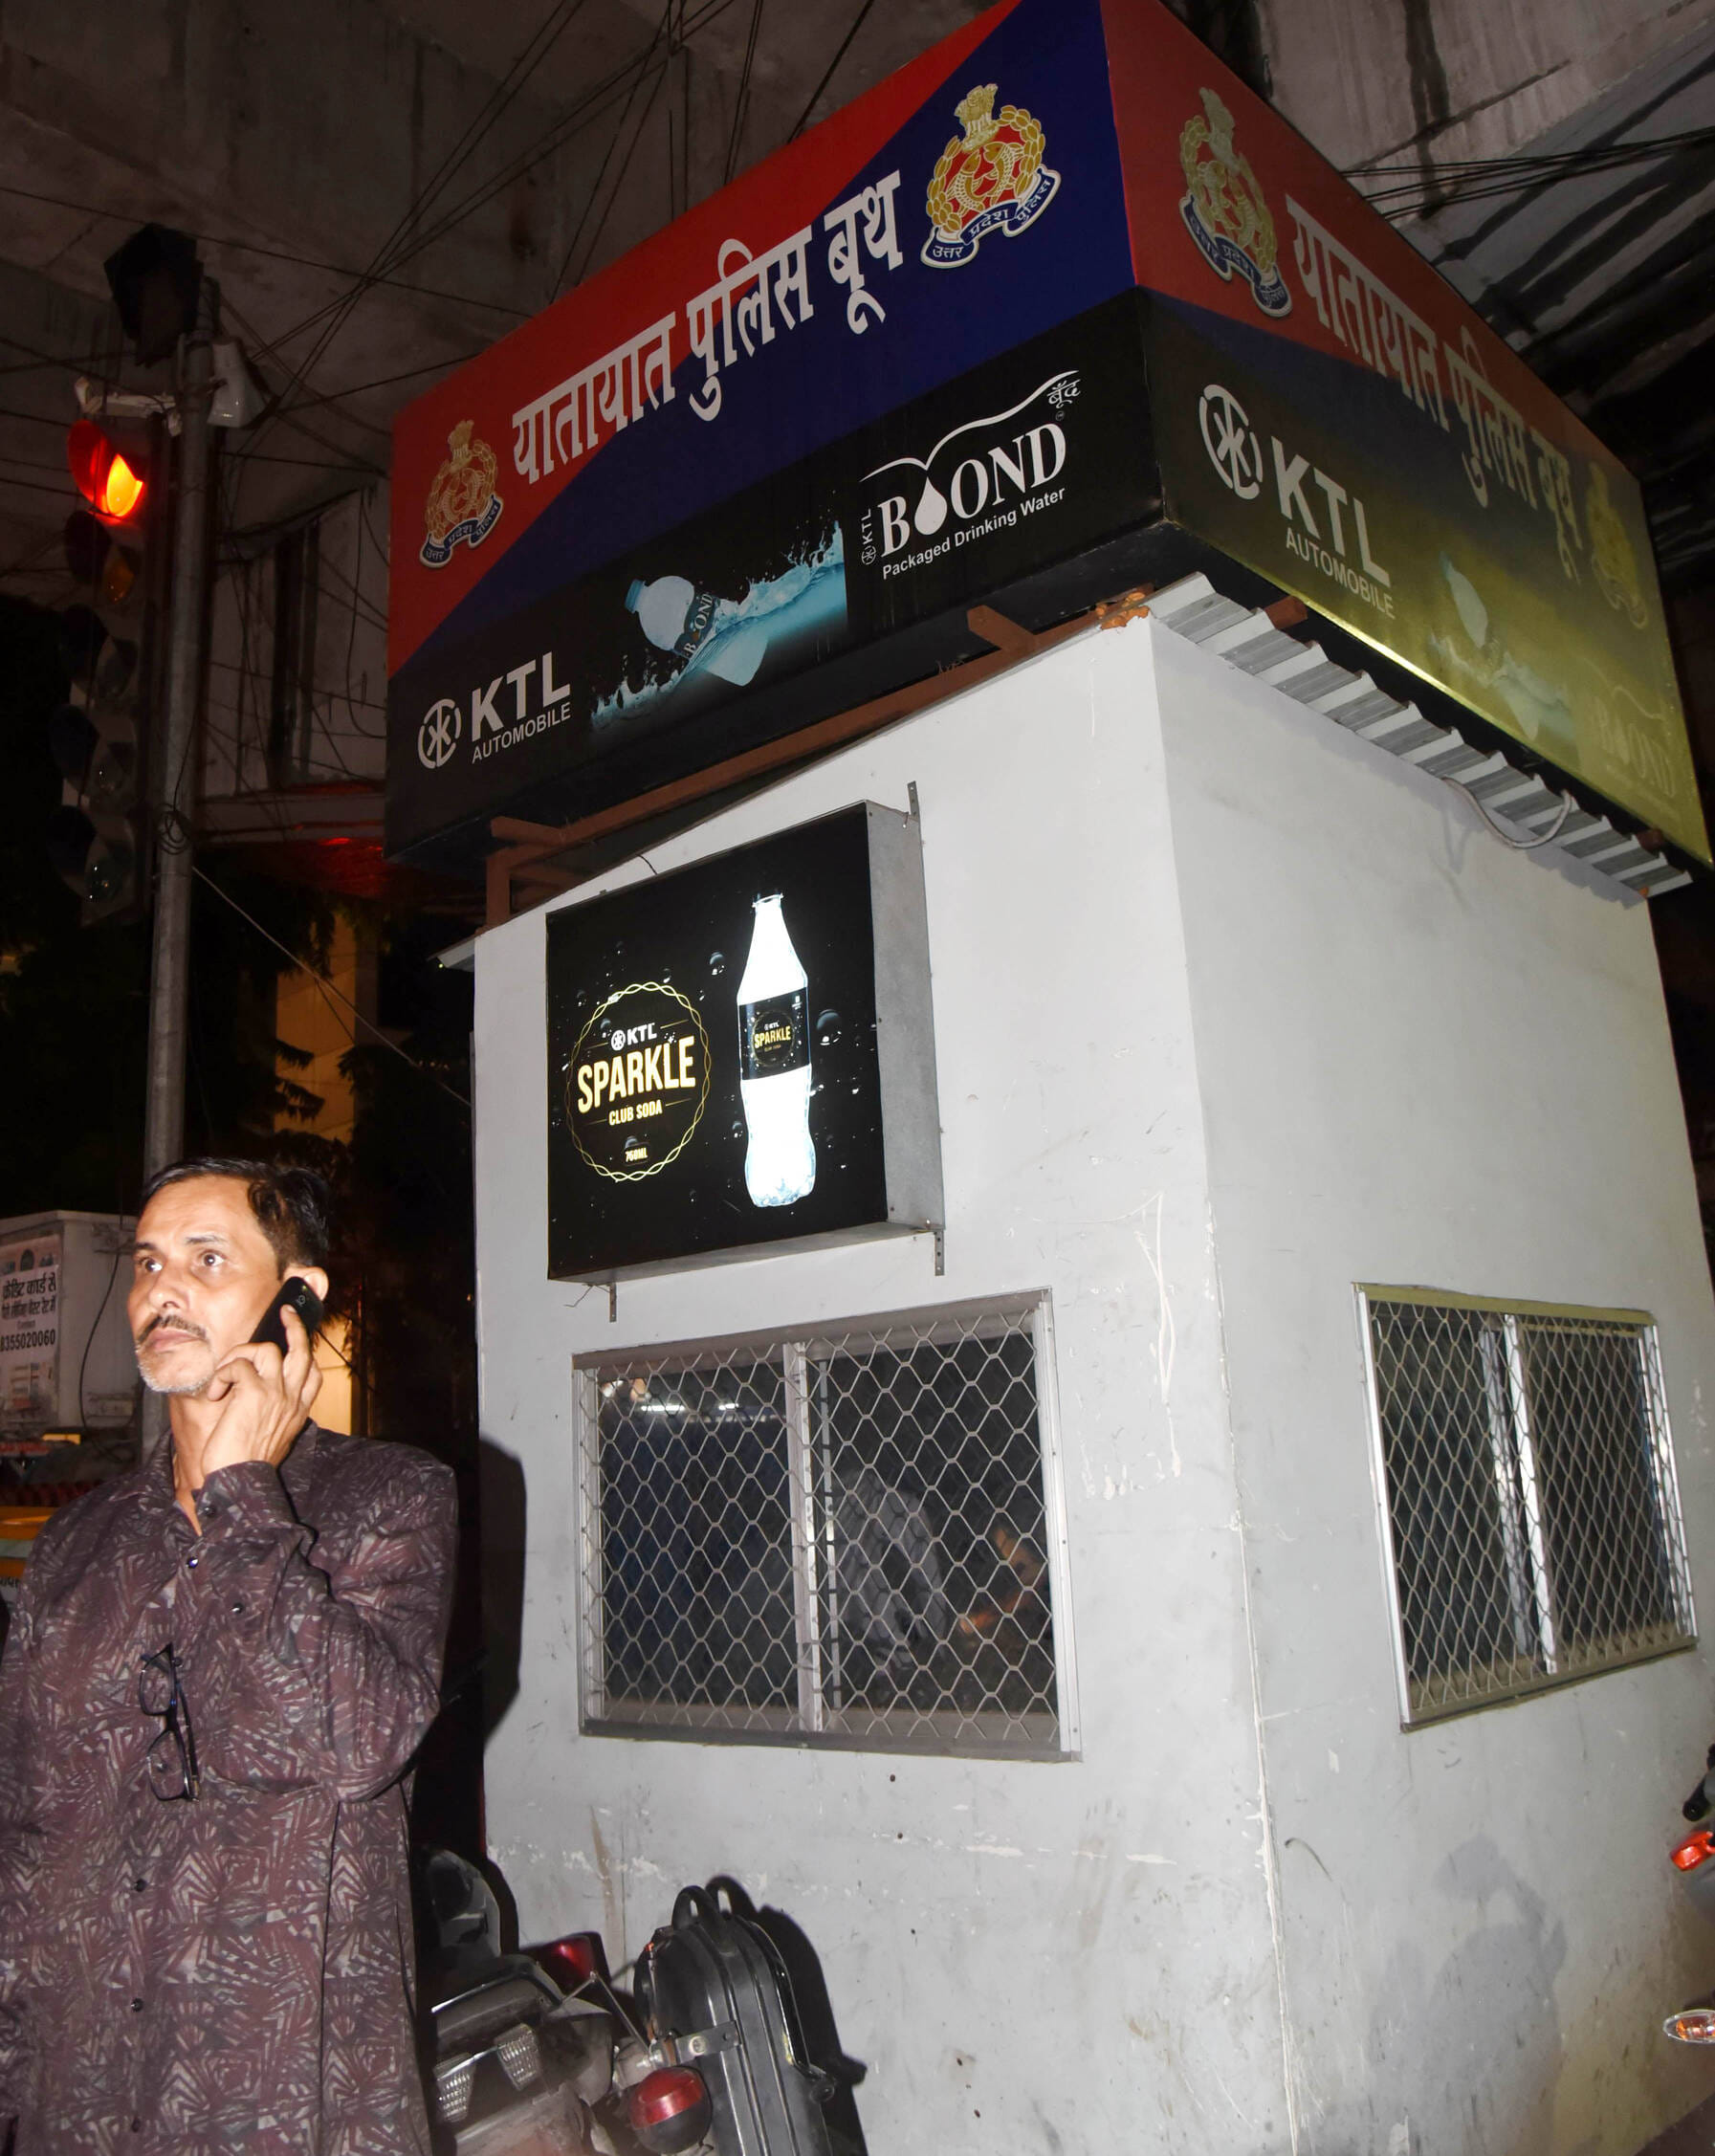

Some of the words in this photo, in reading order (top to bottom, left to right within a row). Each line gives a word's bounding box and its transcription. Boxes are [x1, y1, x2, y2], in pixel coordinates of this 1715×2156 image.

[932, 244, 965, 259] उत्तर
[968, 208, 1009, 237] प्रदेश
[1017, 180, 1051, 226] पुलिस
[512, 311, 676, 485] यातायात
[686, 238, 814, 422] पुलिस
[824, 169, 904, 335] बूथ
[1285, 193, 1450, 432] यातायात
[1443, 324, 1538, 509] पुलिस
[861, 508, 872, 545] KTL
[882, 537, 951, 580] Packaged
[955, 509, 1017, 547] Drinking
[1021, 488, 1066, 517] Water
[1271, 435, 1392, 588] KTL
[1286, 527, 1396, 620] AUTOMOBILE
[472, 651, 571, 742] KTL
[472, 702, 572, 764] AUTOMOBILE
[627, 1023, 657, 1045] KTL
[754, 1025, 792, 1049] SPARKLE
[577, 1035, 696, 1114] SPARKLE
[608, 1106, 635, 1126] CLUB
[636, 1099, 663, 1119] SODA
